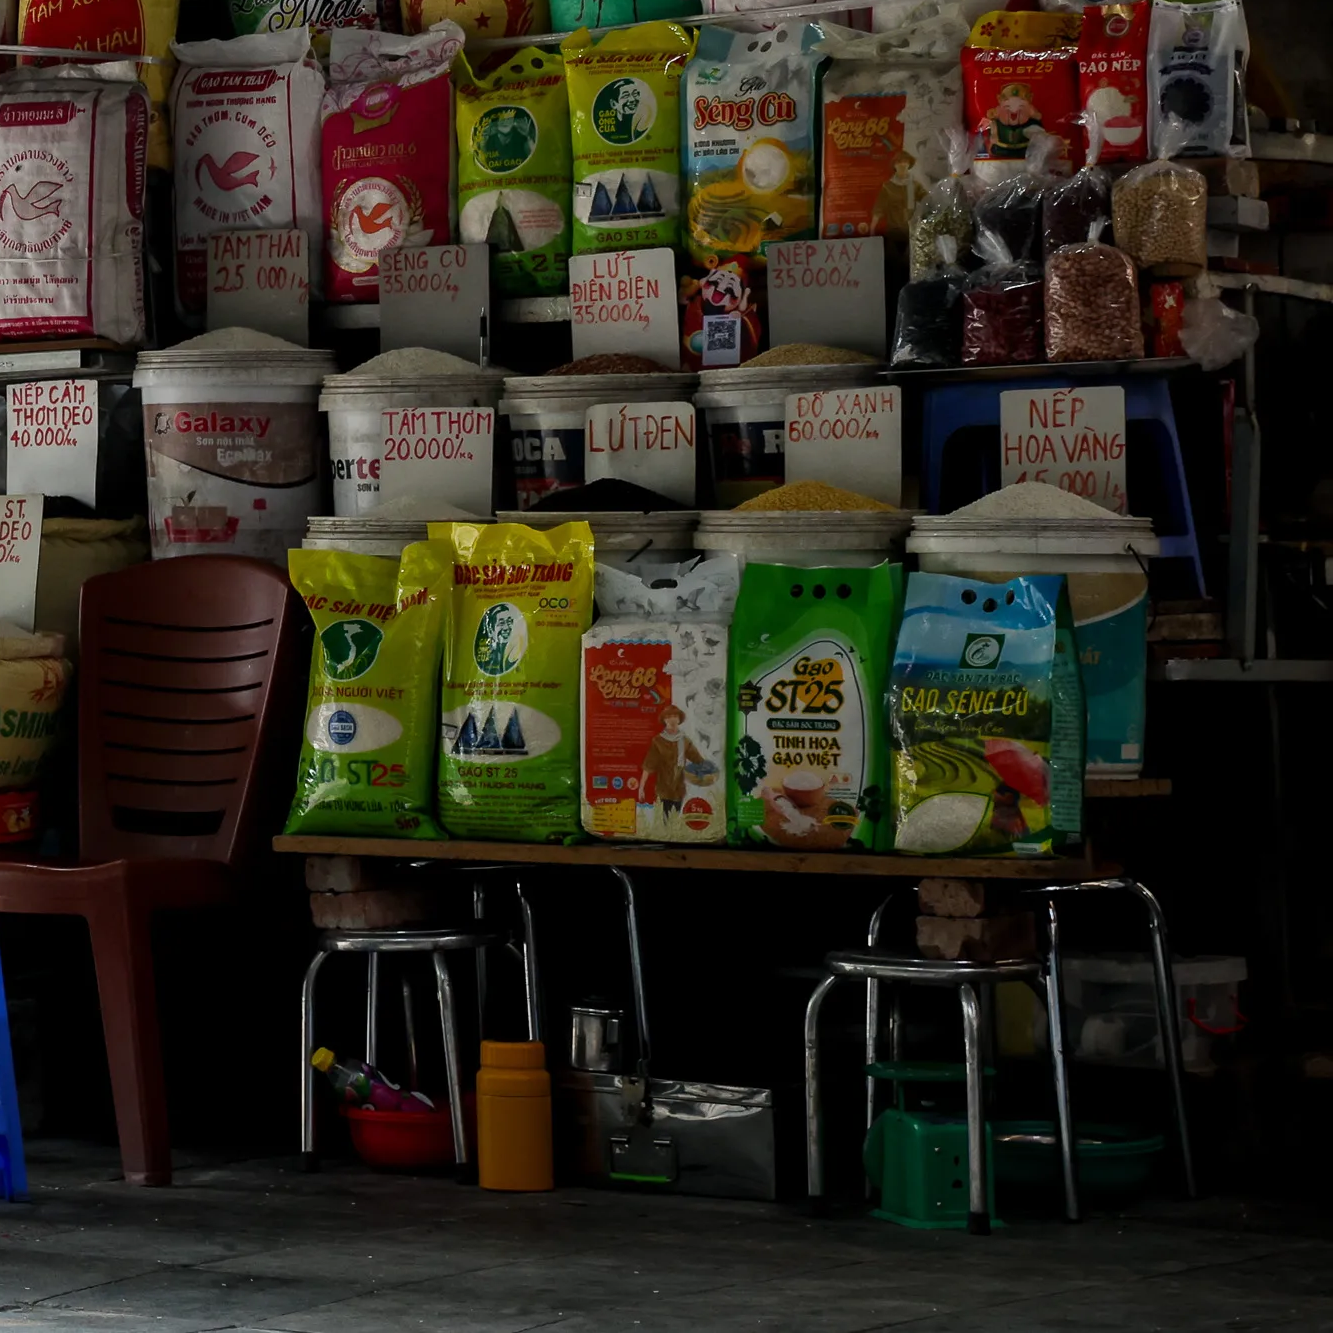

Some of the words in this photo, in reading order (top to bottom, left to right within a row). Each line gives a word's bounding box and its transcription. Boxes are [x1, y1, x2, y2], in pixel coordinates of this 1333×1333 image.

[1112, 54, 1142, 73] NẾP
[694, 96, 755, 131] Séng
[757, 91, 797, 127] Cù
[626, 229, 641, 242] ST
[644, 229, 659, 240] 25
[12, 381, 44, 406] NẾP
[835, 392, 895, 418] XANH
[13, 406, 58, 427] THƠM
[1029, 389, 1085, 429] NẾP
[174, 410, 271, 438] Galaxy
[644, 413, 694, 451] ĐEN
[1004, 434, 1056, 466] HOA
[1063, 426, 1126, 463] VÀNG
[793, 656, 834, 681] Gạo
[765, 679, 845, 714] ST25
[773, 735, 806, 750] TINH
[809, 735, 841, 750] HOA
[486, 767, 501, 777] ST
[504, 767, 518, 778] 25
[772, 751, 803, 768] GẠO
[807, 751, 841, 769] VIỆT
